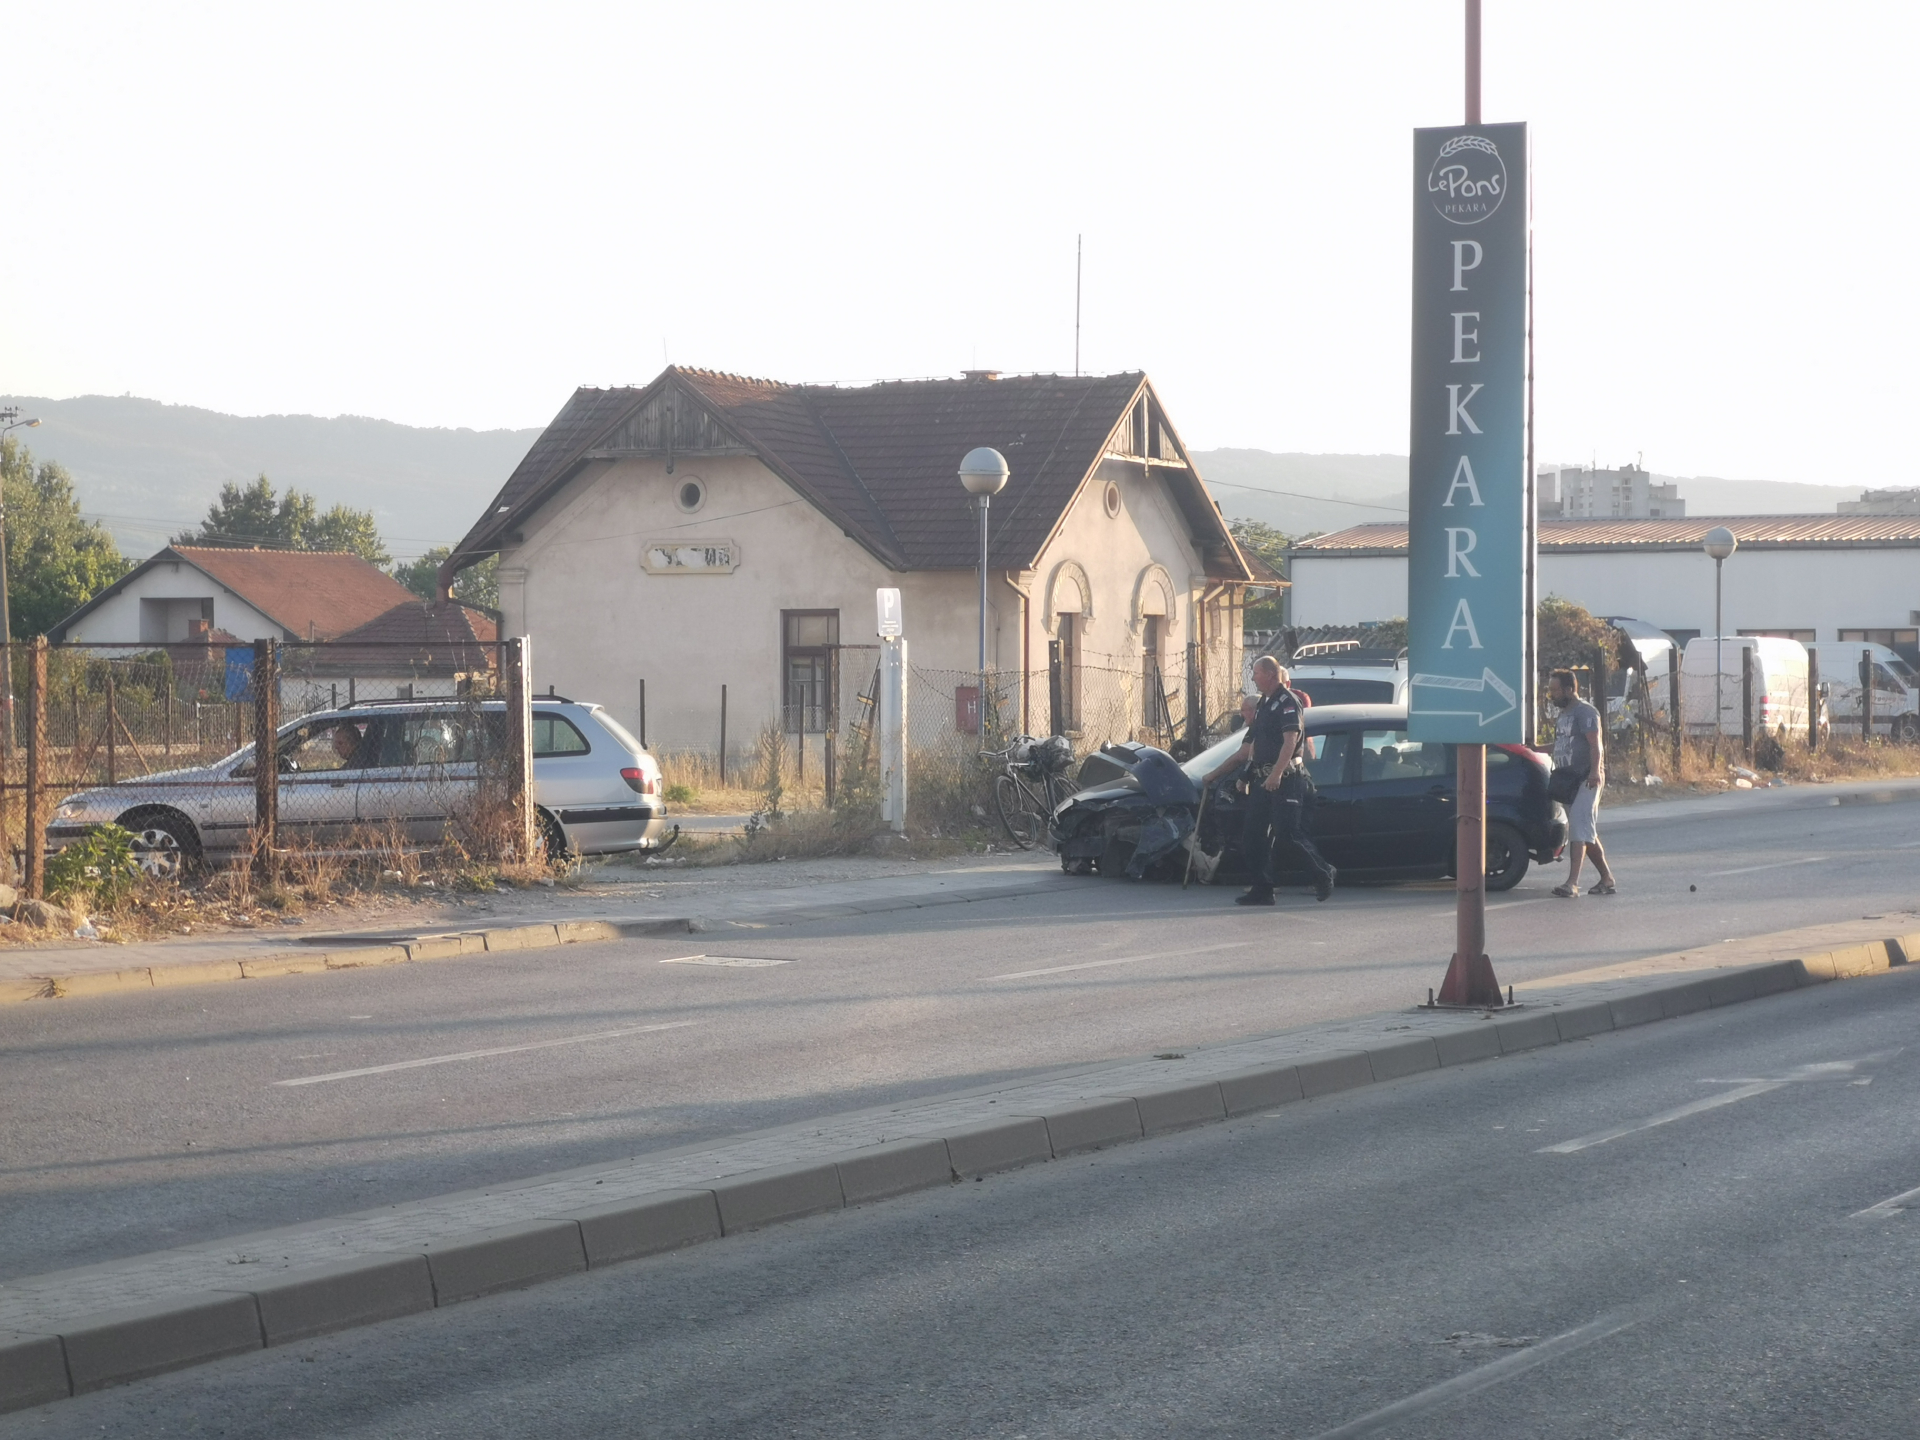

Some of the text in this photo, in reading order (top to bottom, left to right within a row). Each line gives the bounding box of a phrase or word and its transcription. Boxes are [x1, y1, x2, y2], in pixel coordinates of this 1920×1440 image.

[1445, 203, 1487, 213] PEKARA
[1441, 240, 1485, 649] PEKARA
[884, 590, 894, 618] P
[967, 701, 976, 714] H
